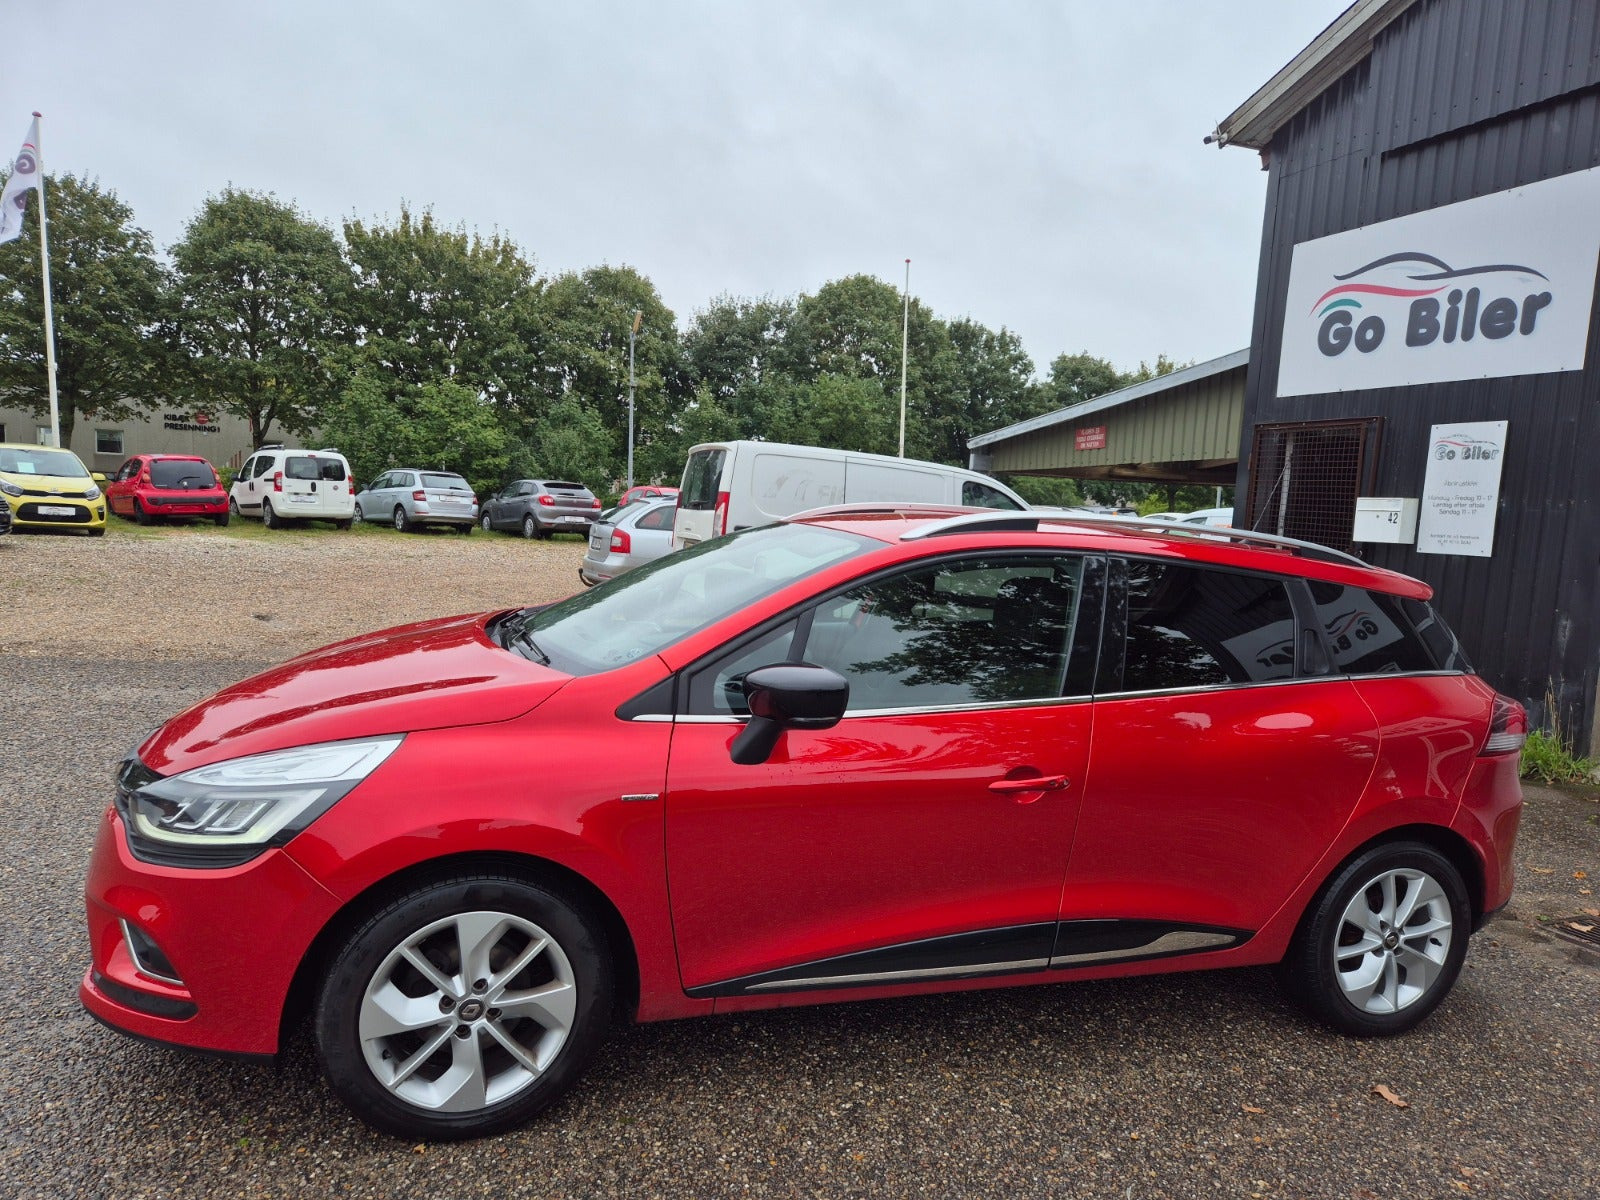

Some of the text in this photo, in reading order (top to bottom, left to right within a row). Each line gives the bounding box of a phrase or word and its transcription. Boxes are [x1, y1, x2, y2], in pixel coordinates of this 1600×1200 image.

[1317, 287, 1553, 357] Go Biler
[1434, 445, 1500, 461] Go Biler
[1388, 512, 1399, 524] 42
